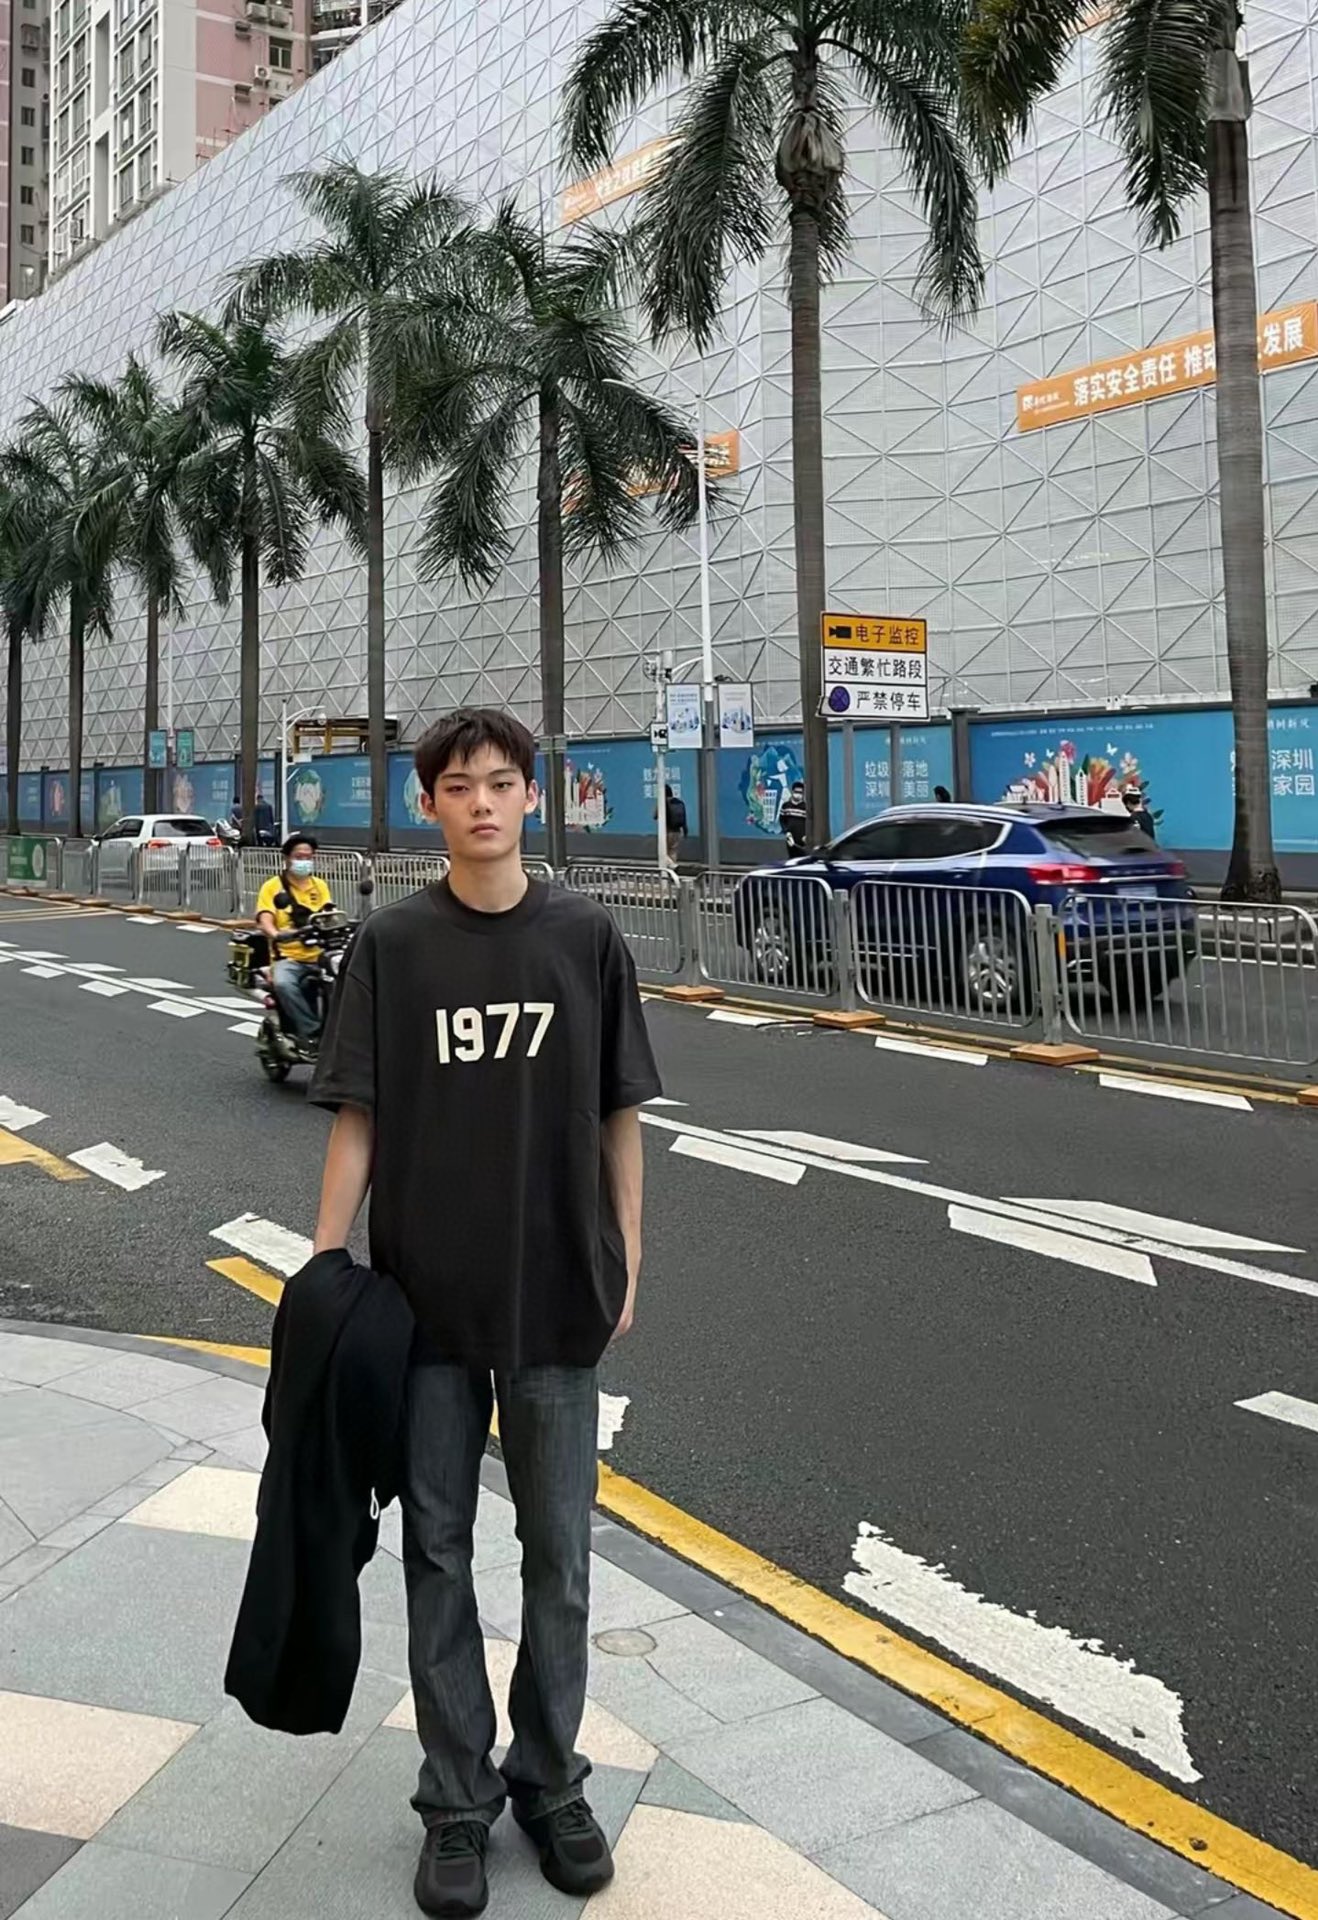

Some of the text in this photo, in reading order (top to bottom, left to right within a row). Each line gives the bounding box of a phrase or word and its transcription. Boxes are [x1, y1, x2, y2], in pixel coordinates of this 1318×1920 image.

[1073, 352, 1178, 407] 落实安全责任
[855, 624, 920, 646] 电子监控
[828, 655, 922, 679] 交通繁忙路段
[856, 690, 921, 711] 严禁停车
[865, 760, 929, 778] 垃圾落地
[865, 780, 929, 798] 深圳美丽
[436, 1002, 555, 1064] 1977
